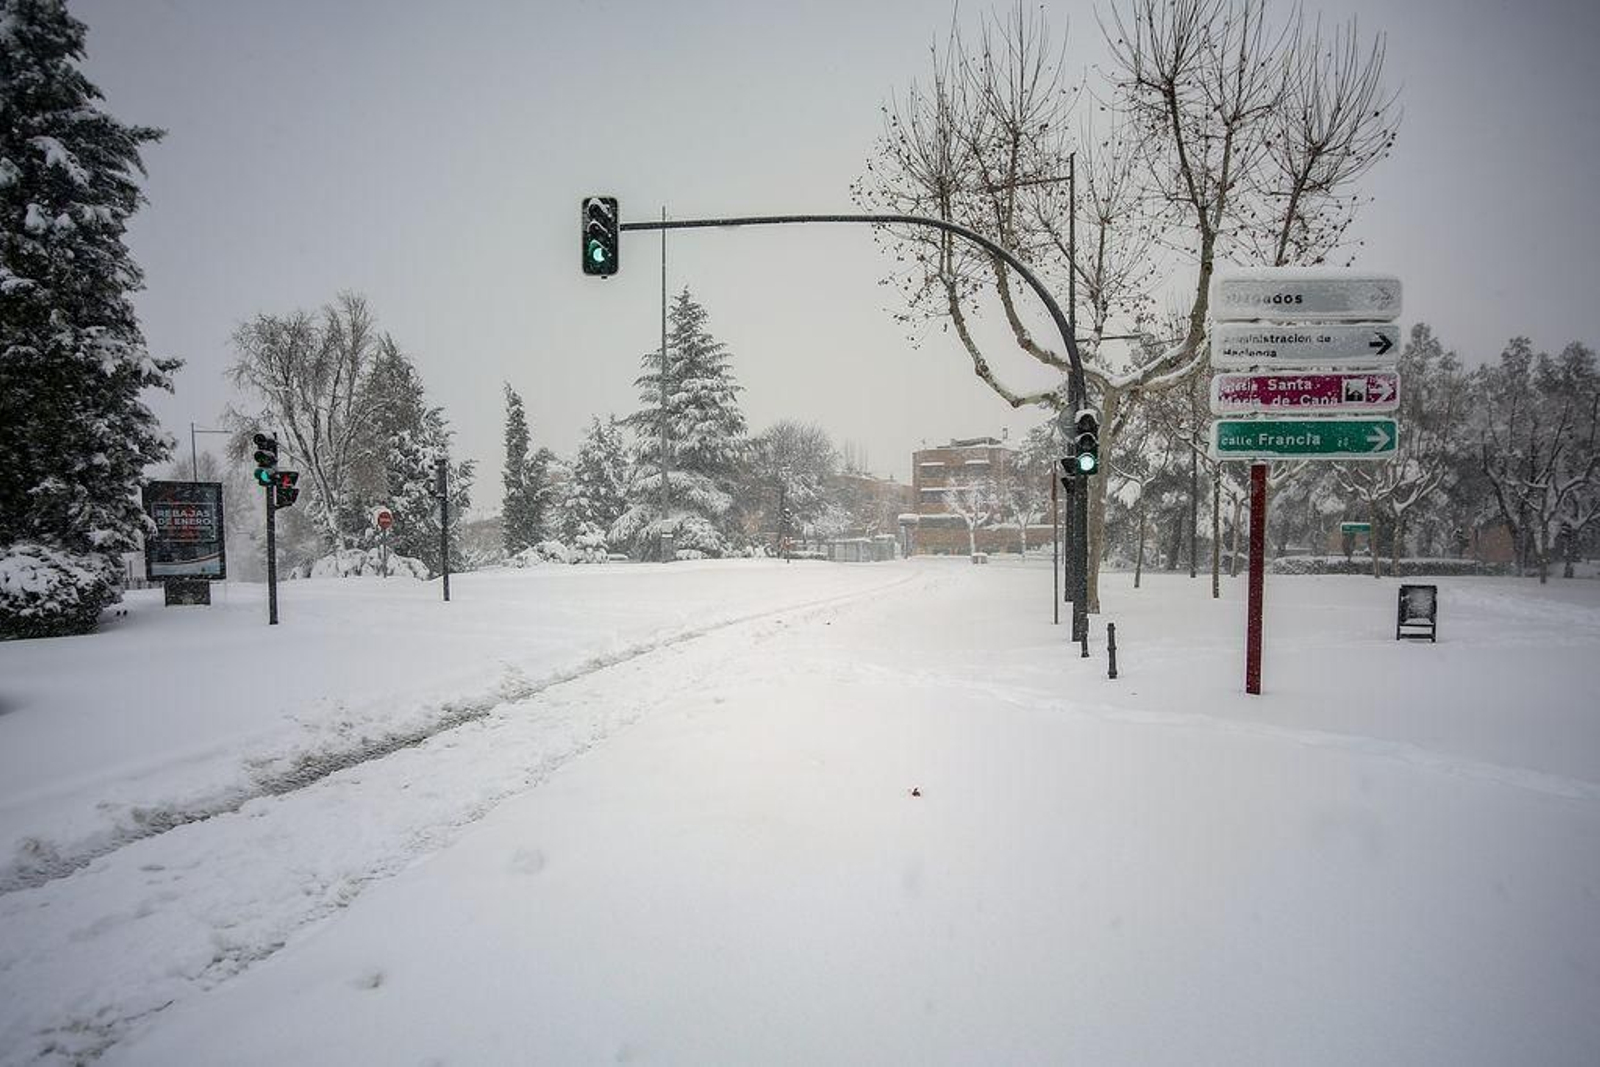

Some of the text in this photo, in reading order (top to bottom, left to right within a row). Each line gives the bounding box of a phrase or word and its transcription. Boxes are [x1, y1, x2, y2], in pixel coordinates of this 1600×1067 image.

[1316, 334, 1332, 344] de
[1267, 378, 1312, 391] Santa
[1272, 395, 1291, 407] de
[1258, 432, 1321, 446] Francia
[157, 509, 210, 518] REBAJAS
[174, 518, 212, 526] ENERO
